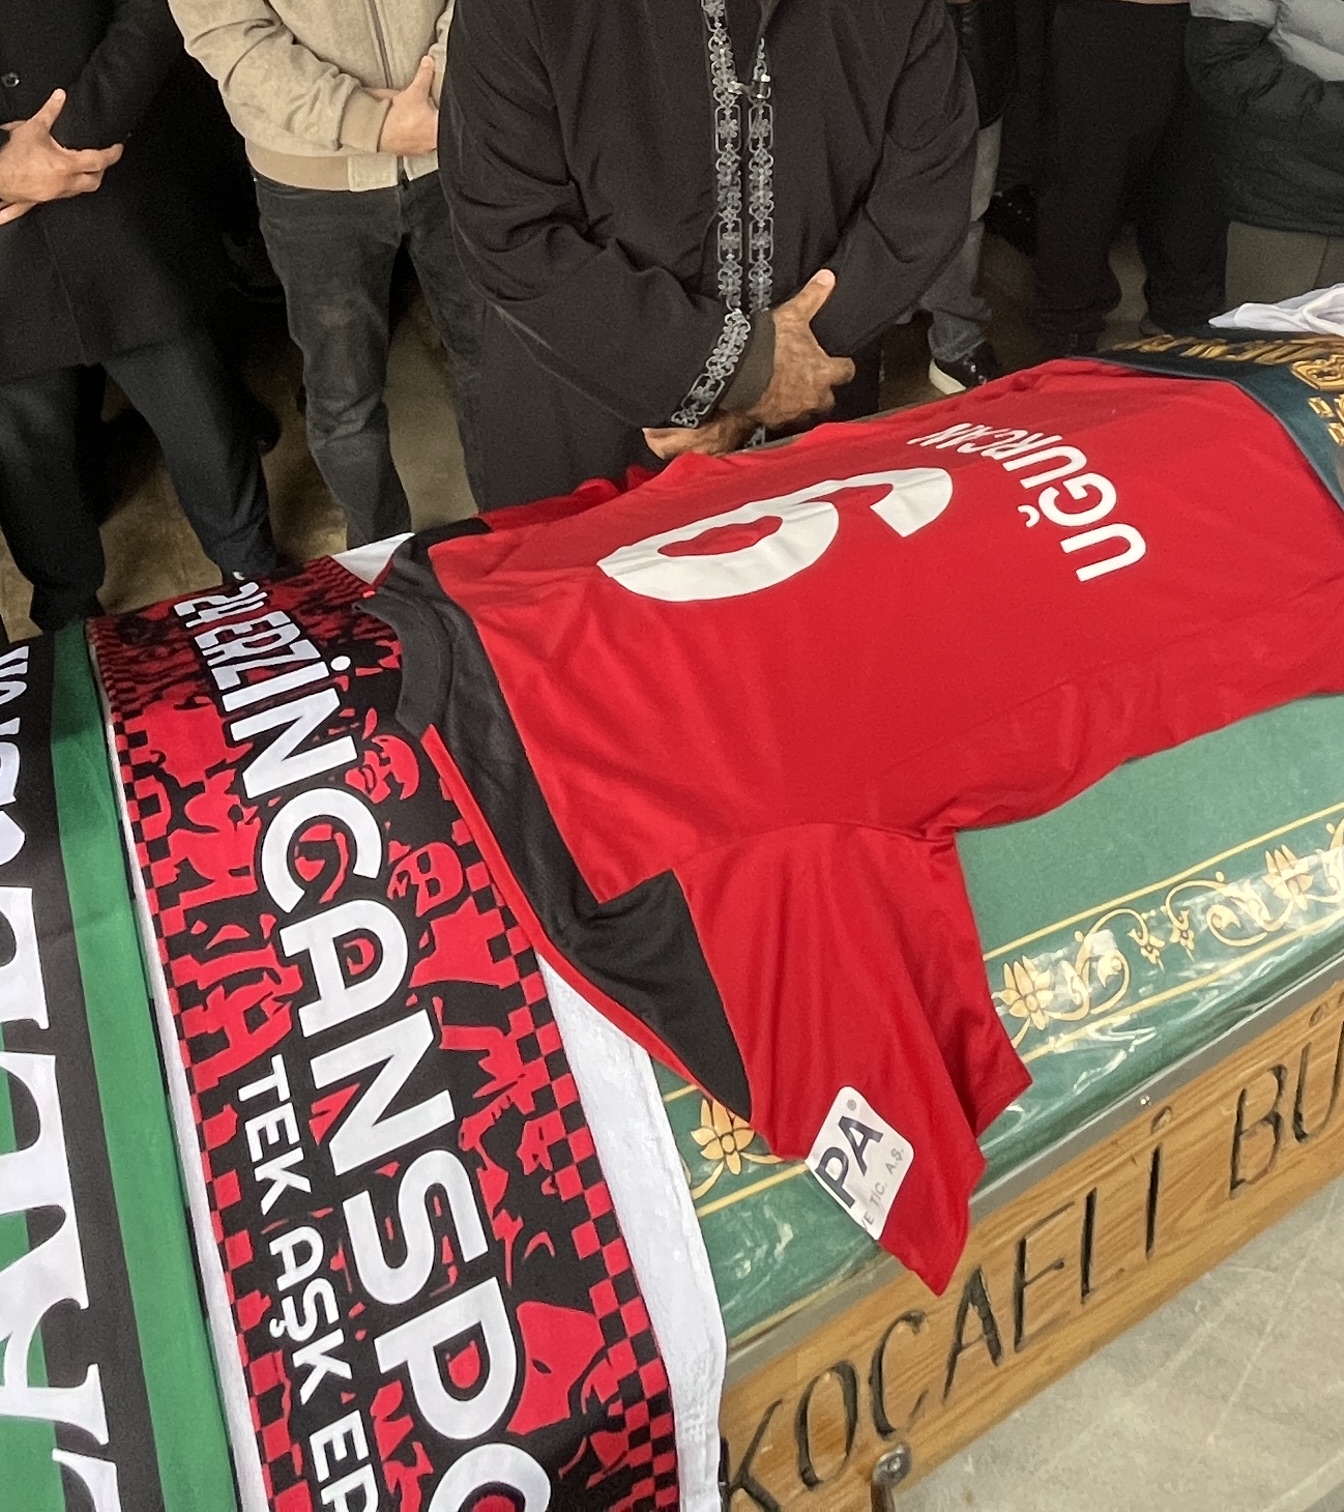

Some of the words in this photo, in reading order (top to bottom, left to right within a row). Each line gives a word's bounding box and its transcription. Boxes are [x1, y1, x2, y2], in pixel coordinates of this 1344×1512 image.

[906, 422, 1147, 583] UĞURCAN
[237, 1053, 313, 1216] TEK
[268, 1225, 353, 1406] AŞK
